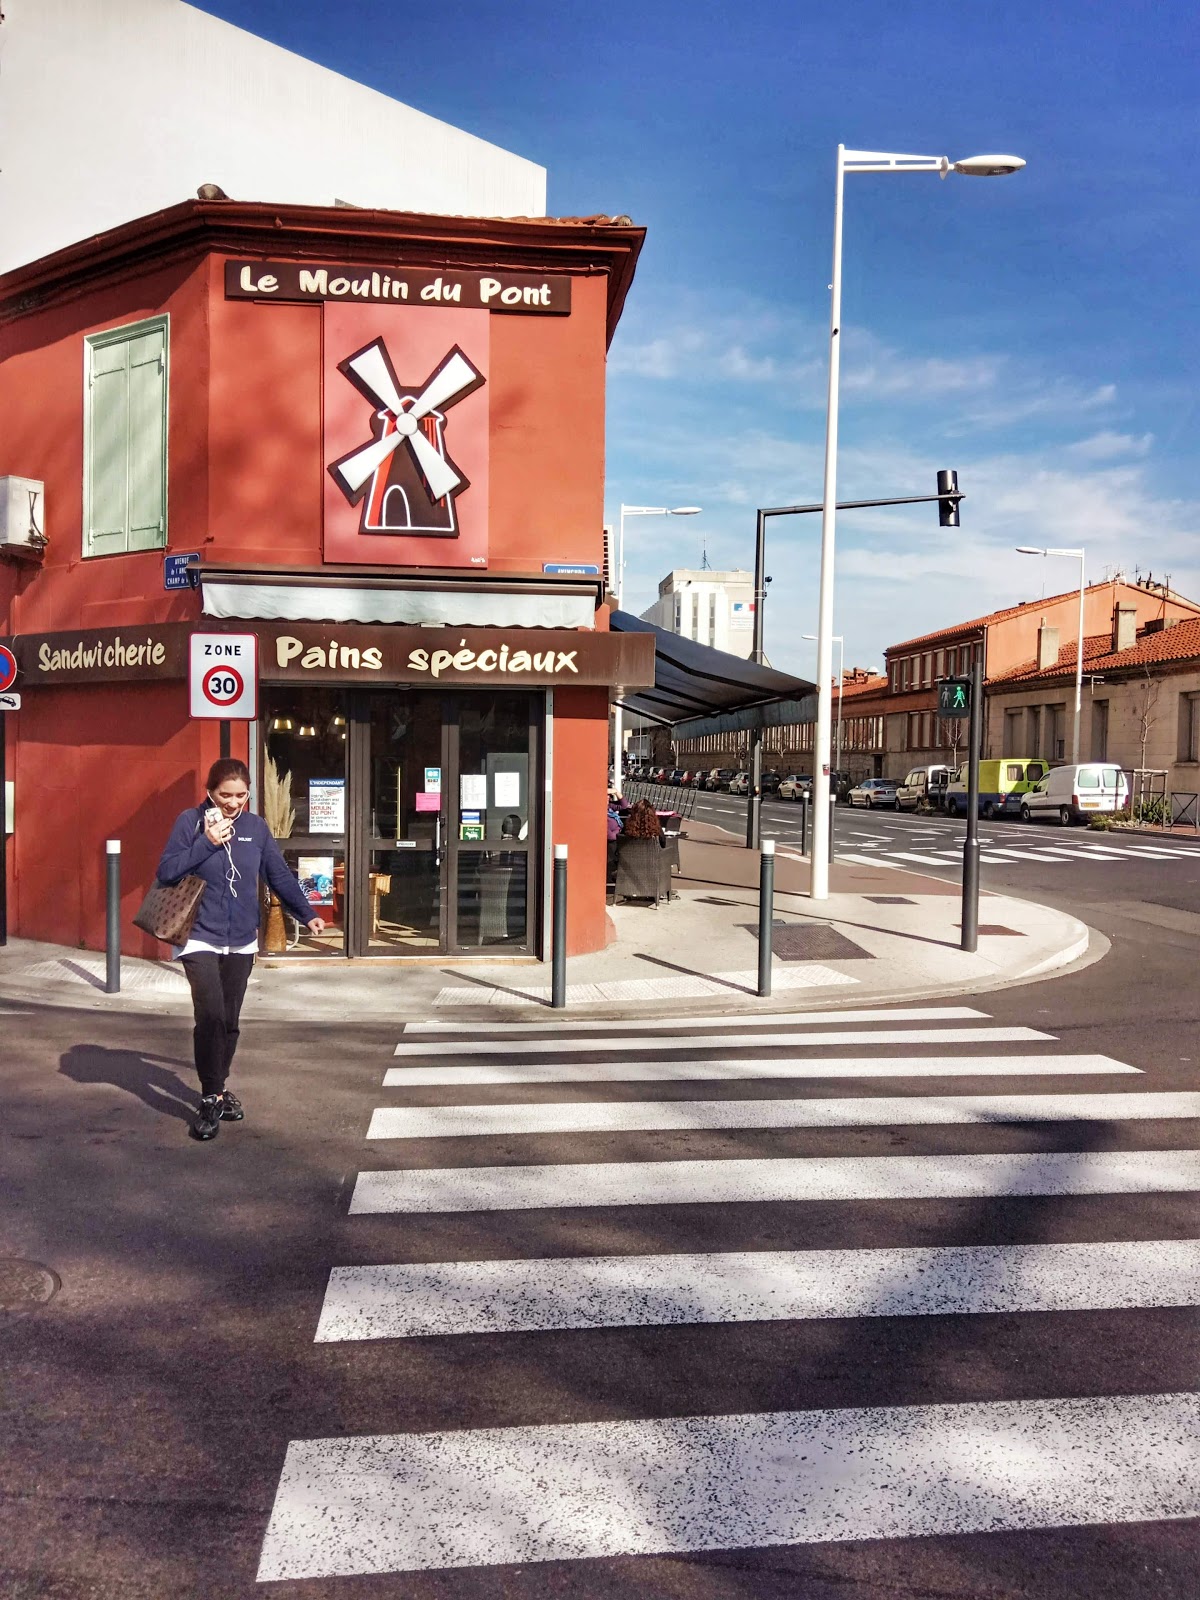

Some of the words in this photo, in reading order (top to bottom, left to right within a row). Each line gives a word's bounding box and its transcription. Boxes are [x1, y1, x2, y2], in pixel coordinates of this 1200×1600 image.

[240, 265, 279, 293] Le
[299, 269, 409, 300] Moulin
[420, 277, 462, 302] du
[479, 277, 552, 306] Pont
[167, 577, 180, 585] CHAMP
[38, 636, 166, 672] Sandwicherie
[204, 644, 242, 656] ZONE
[275, 635, 383, 670] Pains
[406, 638, 579, 679] spéciaux
[210, 677, 236, 695] 30
